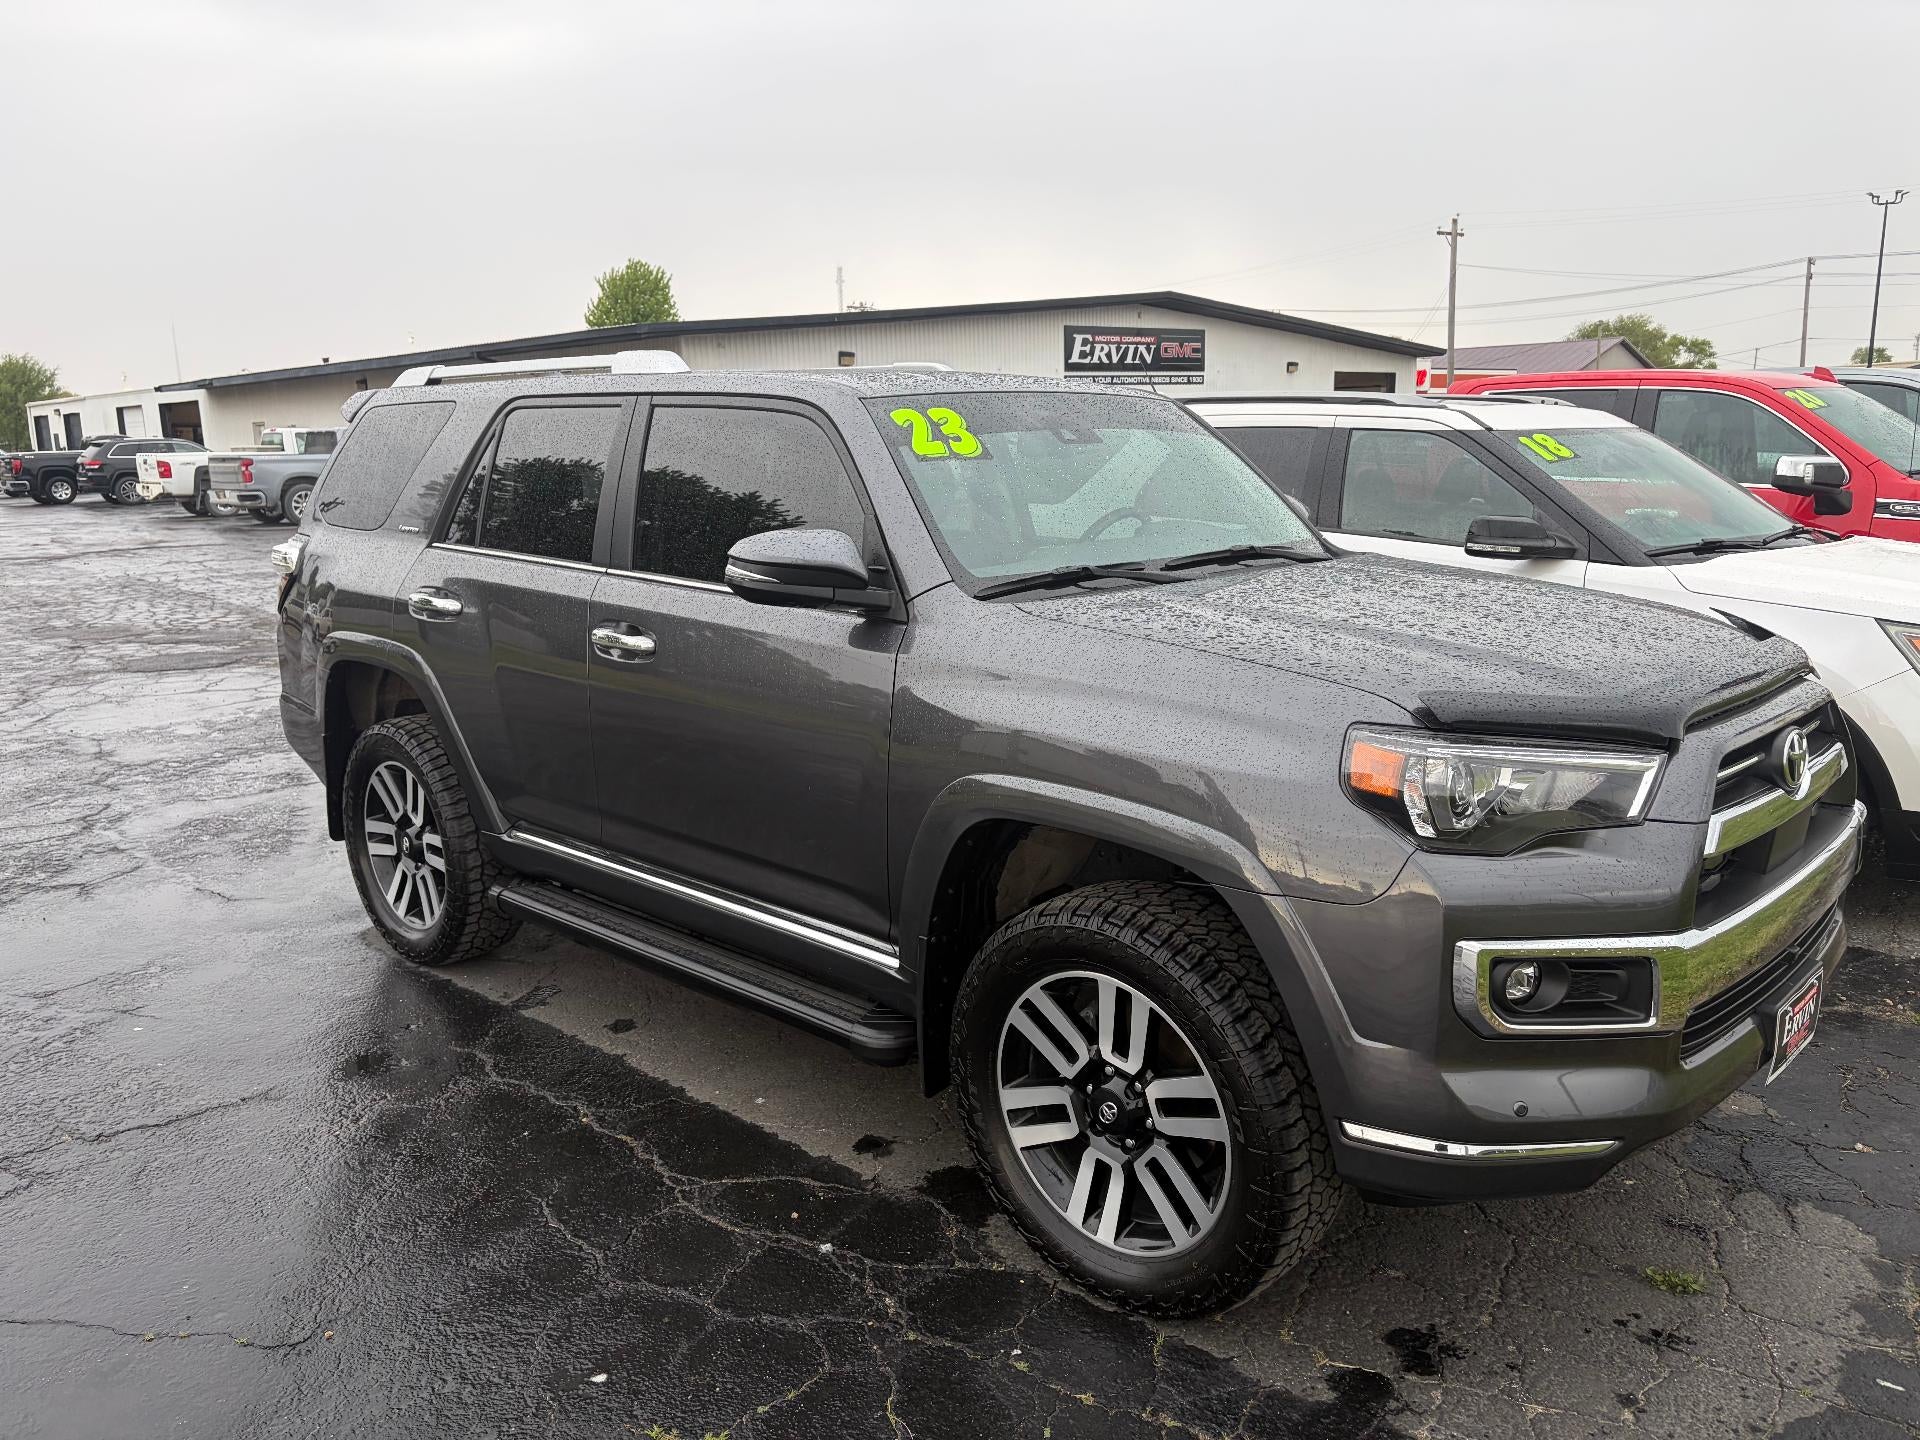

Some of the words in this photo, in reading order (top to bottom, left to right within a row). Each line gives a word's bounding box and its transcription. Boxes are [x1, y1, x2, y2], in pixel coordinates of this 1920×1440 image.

[1068, 333, 1156, 365] ERVIN
[1095, 335, 1121, 343] MOTOR
[1121, 336, 1156, 344] COMPANY
[1160, 342, 1202, 358] GMC
[1094, 376, 1112, 384] YOUR
[1112, 376, 1149, 384] AUTOMOTIVE
[1784, 389, 1828, 409] 20
[889, 407, 983, 458] 23
[1518, 433, 1575, 462] 18
[1781, 993, 1818, 1047] ERVIN
